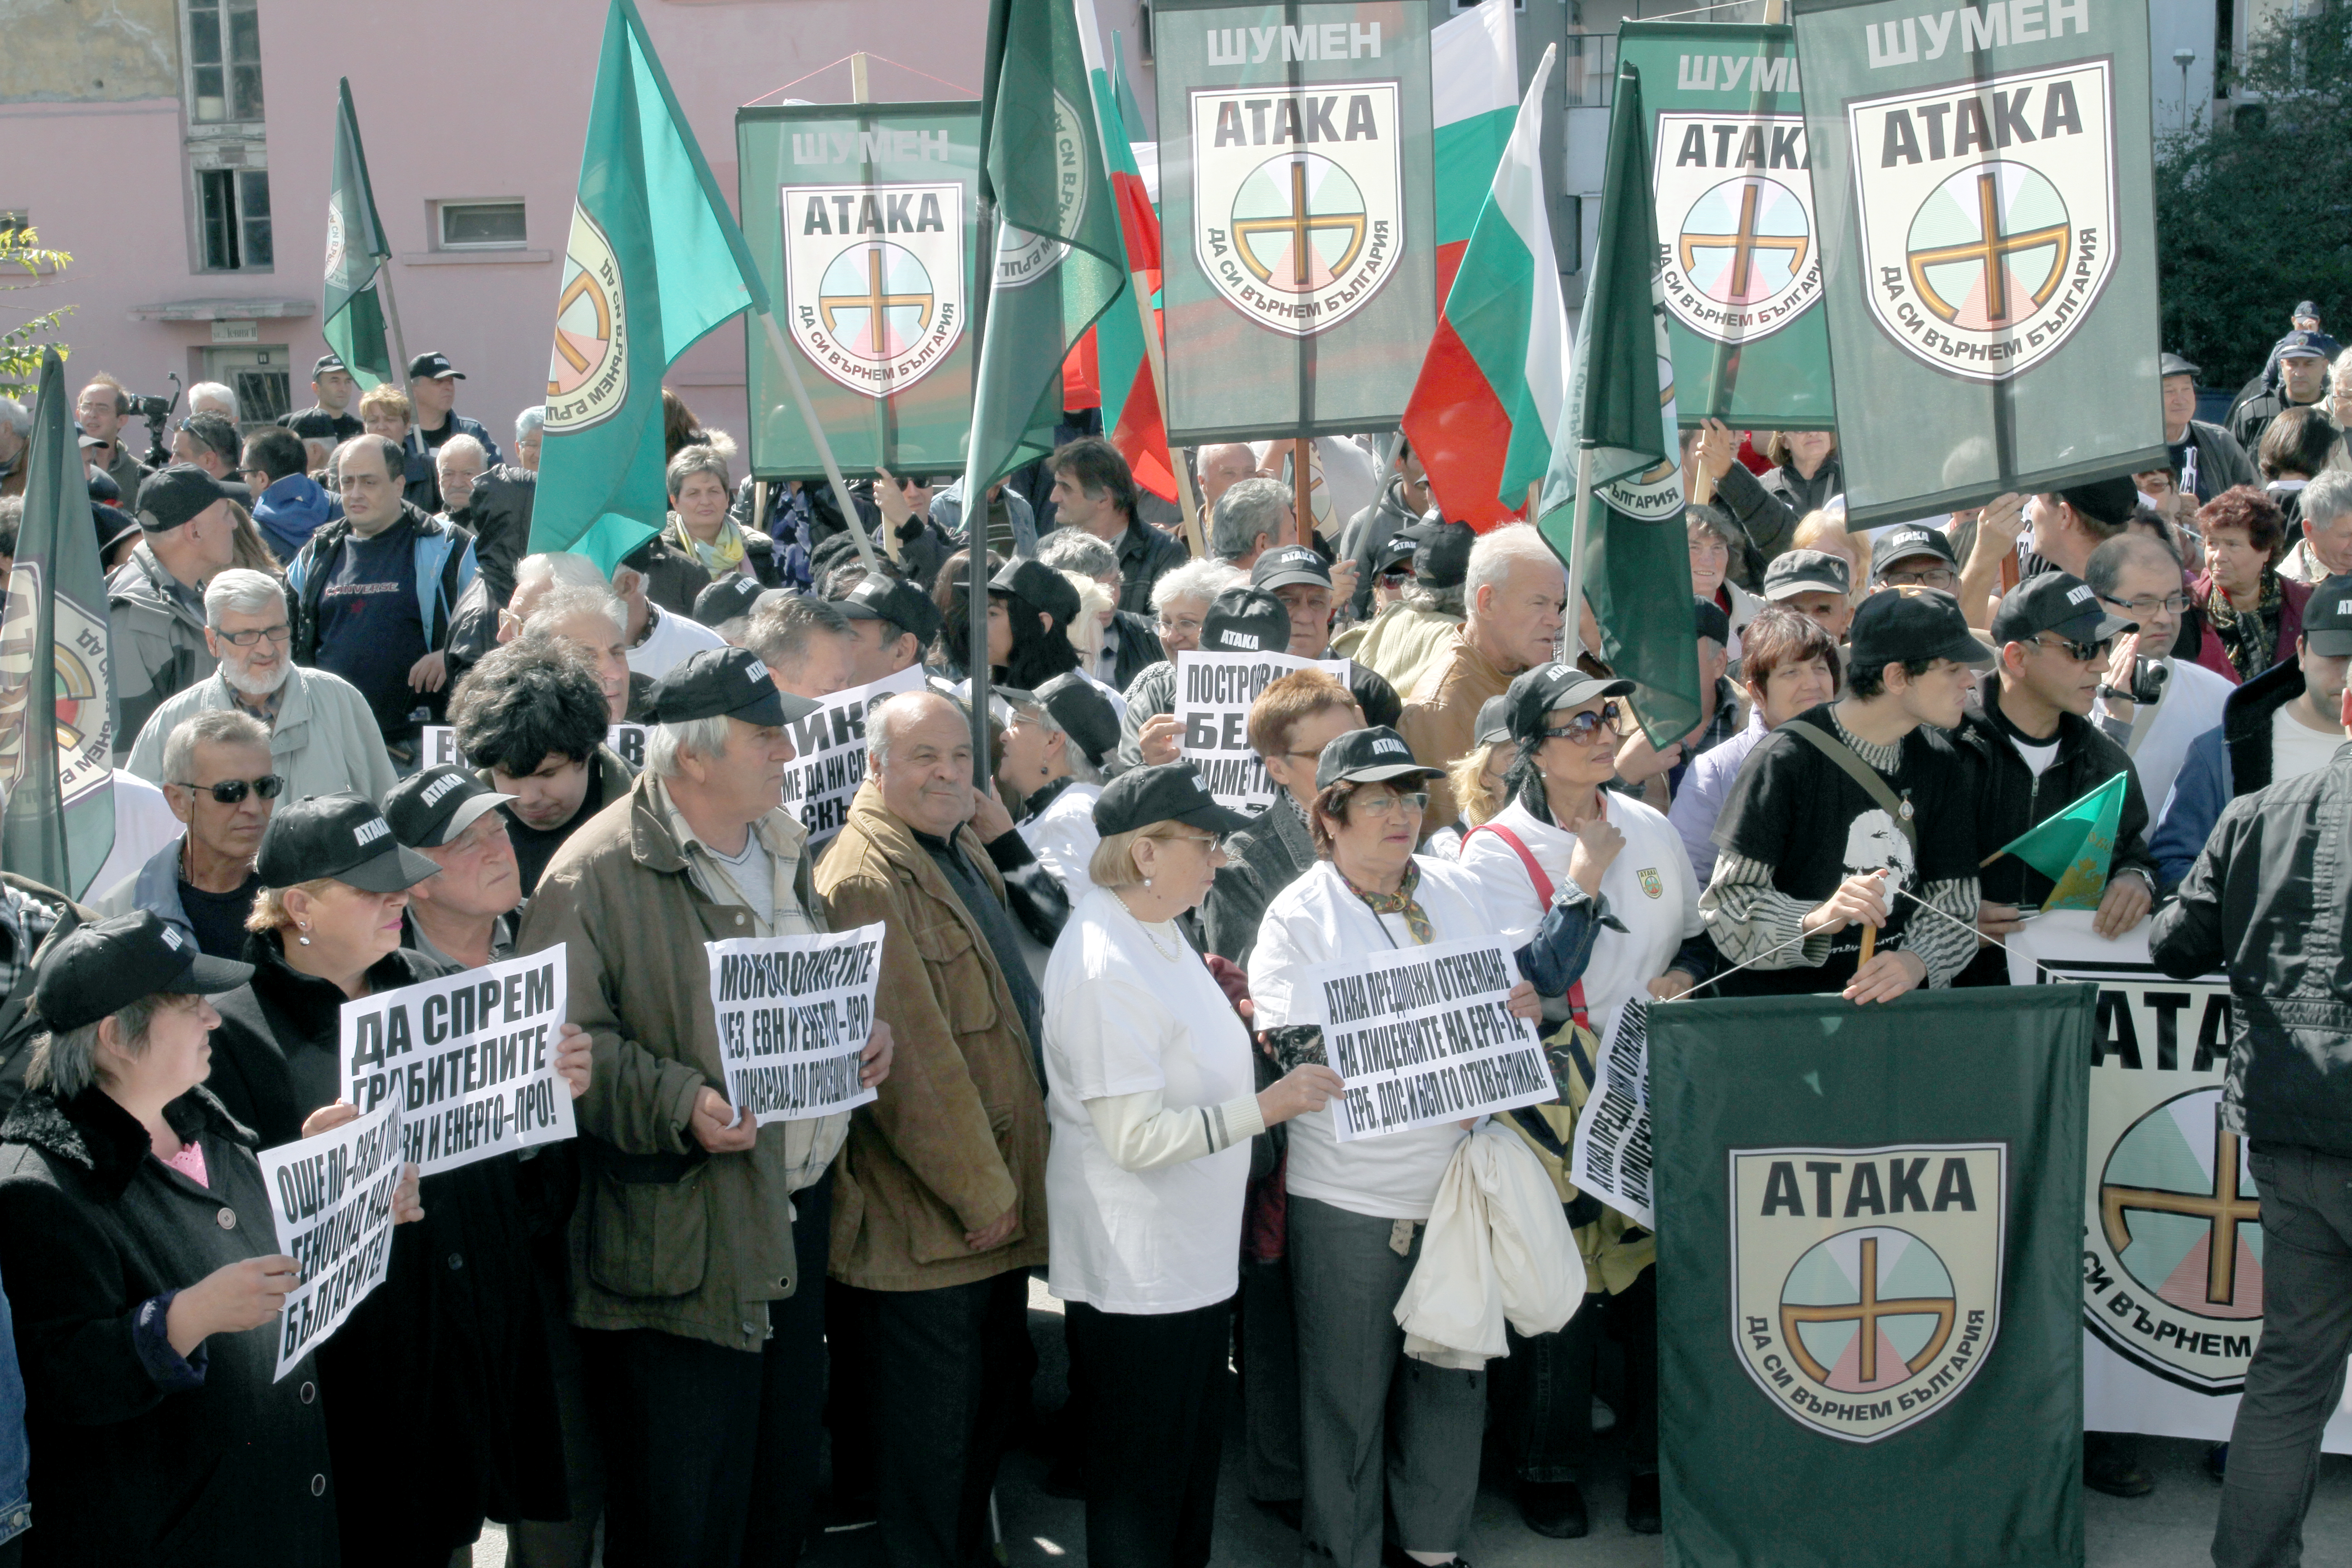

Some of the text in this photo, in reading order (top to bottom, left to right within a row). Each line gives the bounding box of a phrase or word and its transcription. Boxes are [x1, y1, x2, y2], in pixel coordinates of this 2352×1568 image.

[1207, 22, 1381, 66] ШУМЕН
[1866, 0, 2088, 69] ШУМЕН
[792, 130, 948, 165] ШУМЕН
[1214, 94, 1378, 147] АТАКА
[1881, 80, 2083, 168] АТАКА
[804, 193, 944, 235] АТАКА
[1208, 220, 1388, 318] ДА СИ ВЪРНЕМ БЪЛГАРИЯ
[1664, 271, 1685, 294] СИ
[1680, 292, 1753, 327] ВЪРНЕМ
[1881, 228, 2097, 361] ДА СИ ВЪРНЕМ БЪЛГАРИЯ
[799, 303, 954, 381] ДА СИ ВЪРНЕМ БЪЛГАРИЯ
[1281, 550, 1318, 564] АТАКА
[325, 582, 400, 596] CONVERSE
[1220, 629, 1259, 650] АТАКА
[1185, 712, 1251, 750] БЕ
[420, 772, 466, 808] АТАКА
[804, 761, 826, 803] ДА
[825, 754, 846, 791] НИ
[847, 747, 867, 784] СП
[800, 793, 855, 837] СКЪ
[1640, 869, 1657, 878] АТАКА
[719, 941, 877, 1002] МОНОПОЛИСТИТЕ
[1323, 948, 1511, 1025] АТАКА ПРЕДЛОЖИ ОТНЕМАНЕ
[352, 962, 554, 1076] ДА СПРЕМ
[752, 1008, 785, 1056] ЕВН
[1336, 1032, 1360, 1079] НА
[1357, 1015, 1447, 1076] ЛИЦЕНЗИТЕ
[1441, 1009, 1474, 1055] НА
[427, 1112, 441, 1162] И
[443, 1077, 557, 1158] ЕНЕРГО-ПРО!
[789, 1062, 807, 1117] ДО
[1377, 1078, 1408, 1133] ДПС
[1404, 1076, 1420, 1120] И
[1416, 1071, 1446, 1118] БСП
[1440, 1066, 1464, 1112] ГО
[1459, 1048, 1548, 1107] ОТХВЪРЛИХА!
[277, 1153, 325, 1225] ОЩЕ
[1586, 1139, 1614, 1194] АТАКА
[1760, 1157, 1977, 1218] АТАКА
[368, 1164, 399, 1234] НАД
[282, 1226, 388, 1363] БЪЛГАРИТЕ!
[2107, 1291, 2252, 1358] ВЪРНЕМ
[1746, 1309, 1985, 1421] ДА СИ ВЪРНЕМ БЪЛГАРИЯ
